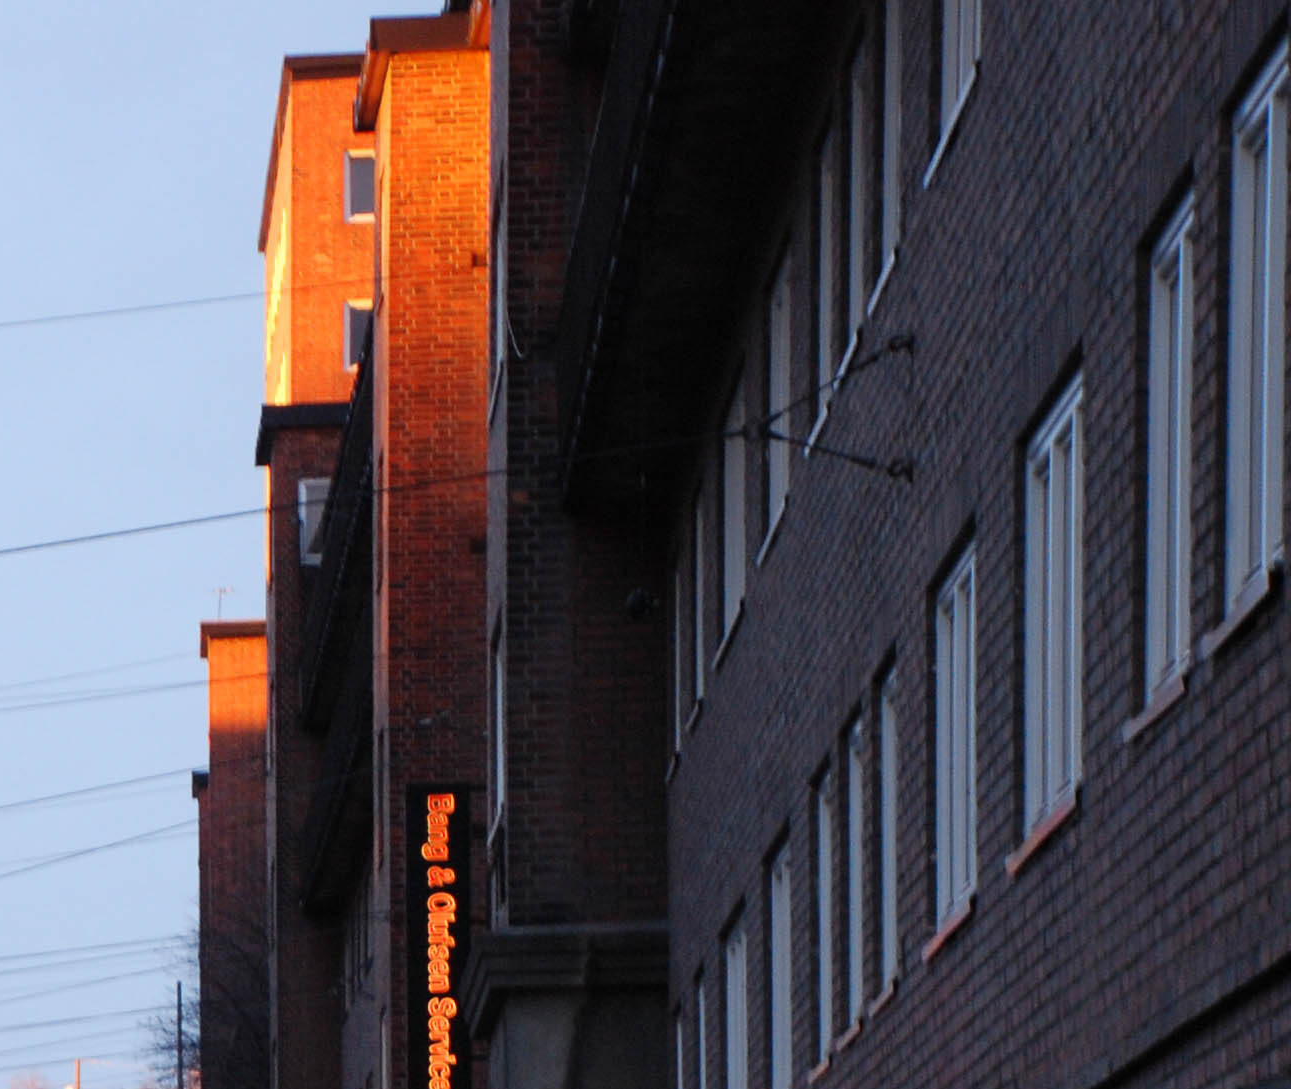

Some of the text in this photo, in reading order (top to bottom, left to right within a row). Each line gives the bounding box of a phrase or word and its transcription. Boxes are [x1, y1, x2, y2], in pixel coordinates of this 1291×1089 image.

[421, 793, 455, 861] Bang
[427, 865, 456, 888] &
[427, 892, 456, 994] Olufsen
